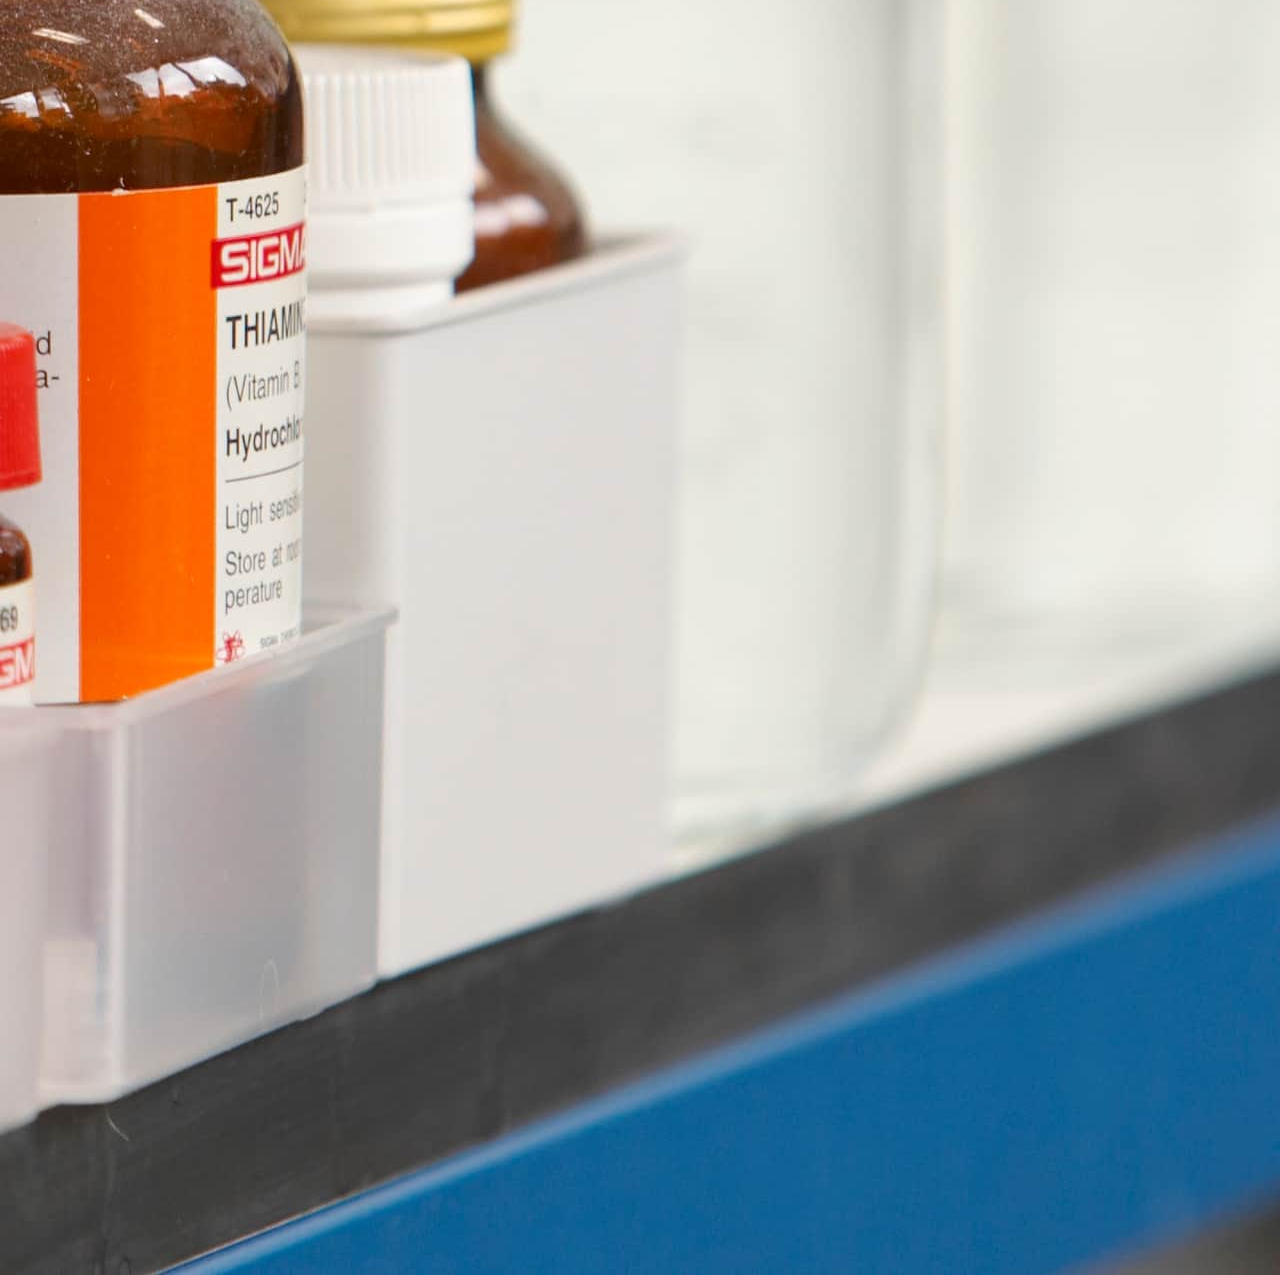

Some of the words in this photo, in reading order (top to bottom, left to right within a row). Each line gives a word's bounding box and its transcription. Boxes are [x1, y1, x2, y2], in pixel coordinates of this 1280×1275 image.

[225, 191, 280, 222] T-4625
[225, 366, 290, 412] (Vitamin
[225, 500, 264, 534] Light
[225, 550, 266, 577] Store
[224, 578, 283, 616] perature
